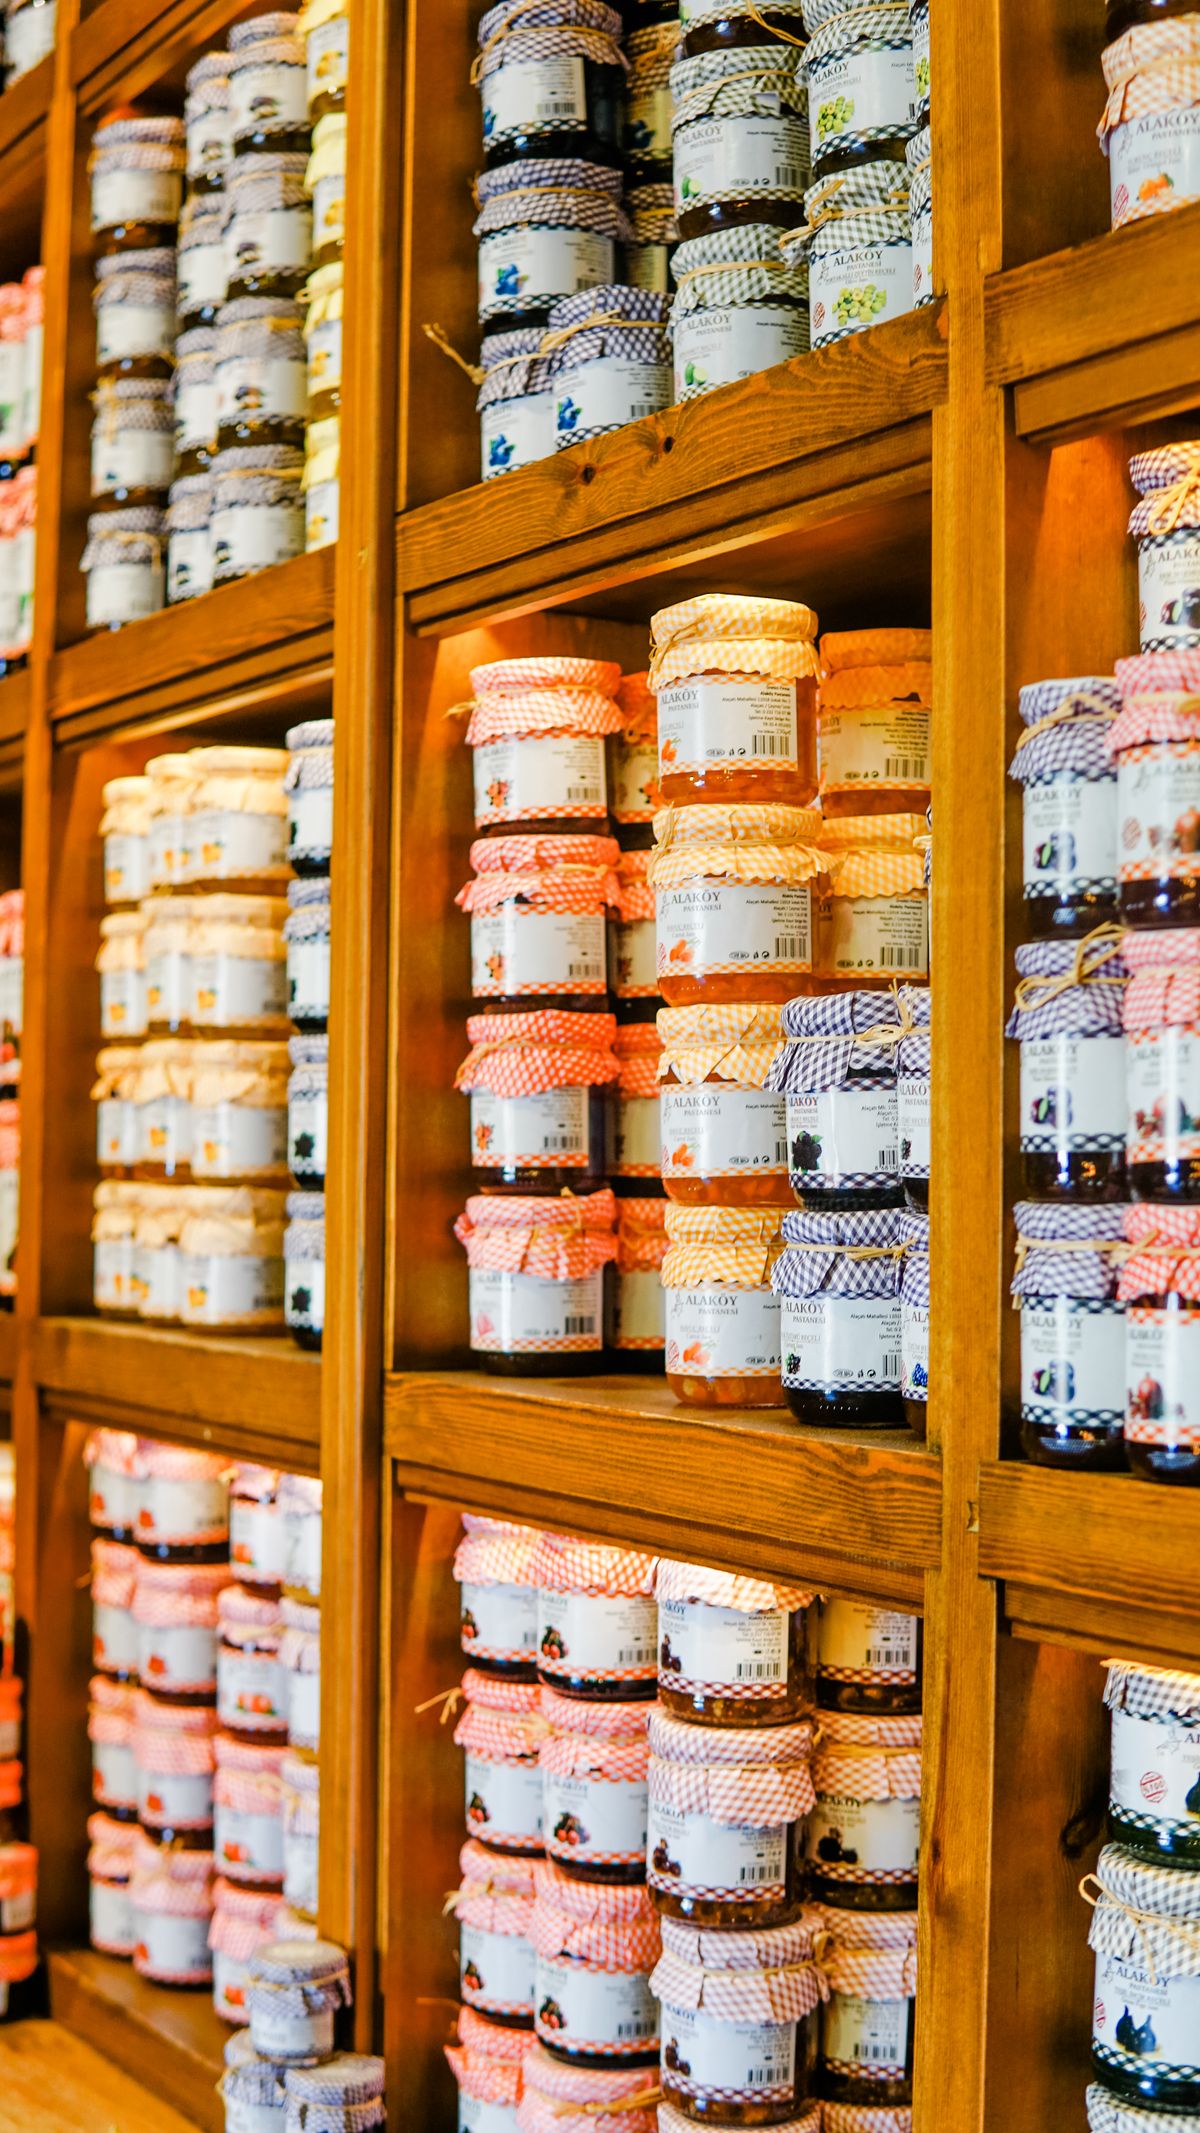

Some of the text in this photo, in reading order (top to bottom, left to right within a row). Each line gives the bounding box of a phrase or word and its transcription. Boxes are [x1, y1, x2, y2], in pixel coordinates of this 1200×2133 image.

[833, 249, 884, 267] ALAKÖY
[661, 688, 699, 705] ALAKÖY
[671, 889, 721, 904] ALAKÖY
[899, 1082, 930, 1096] ALAKÖ
[673, 1094, 720, 1108] ALAKÖY
[686, 1293, 738, 1306] ALAKÖY
[784, 1300, 826, 1314] ALAKÖY
